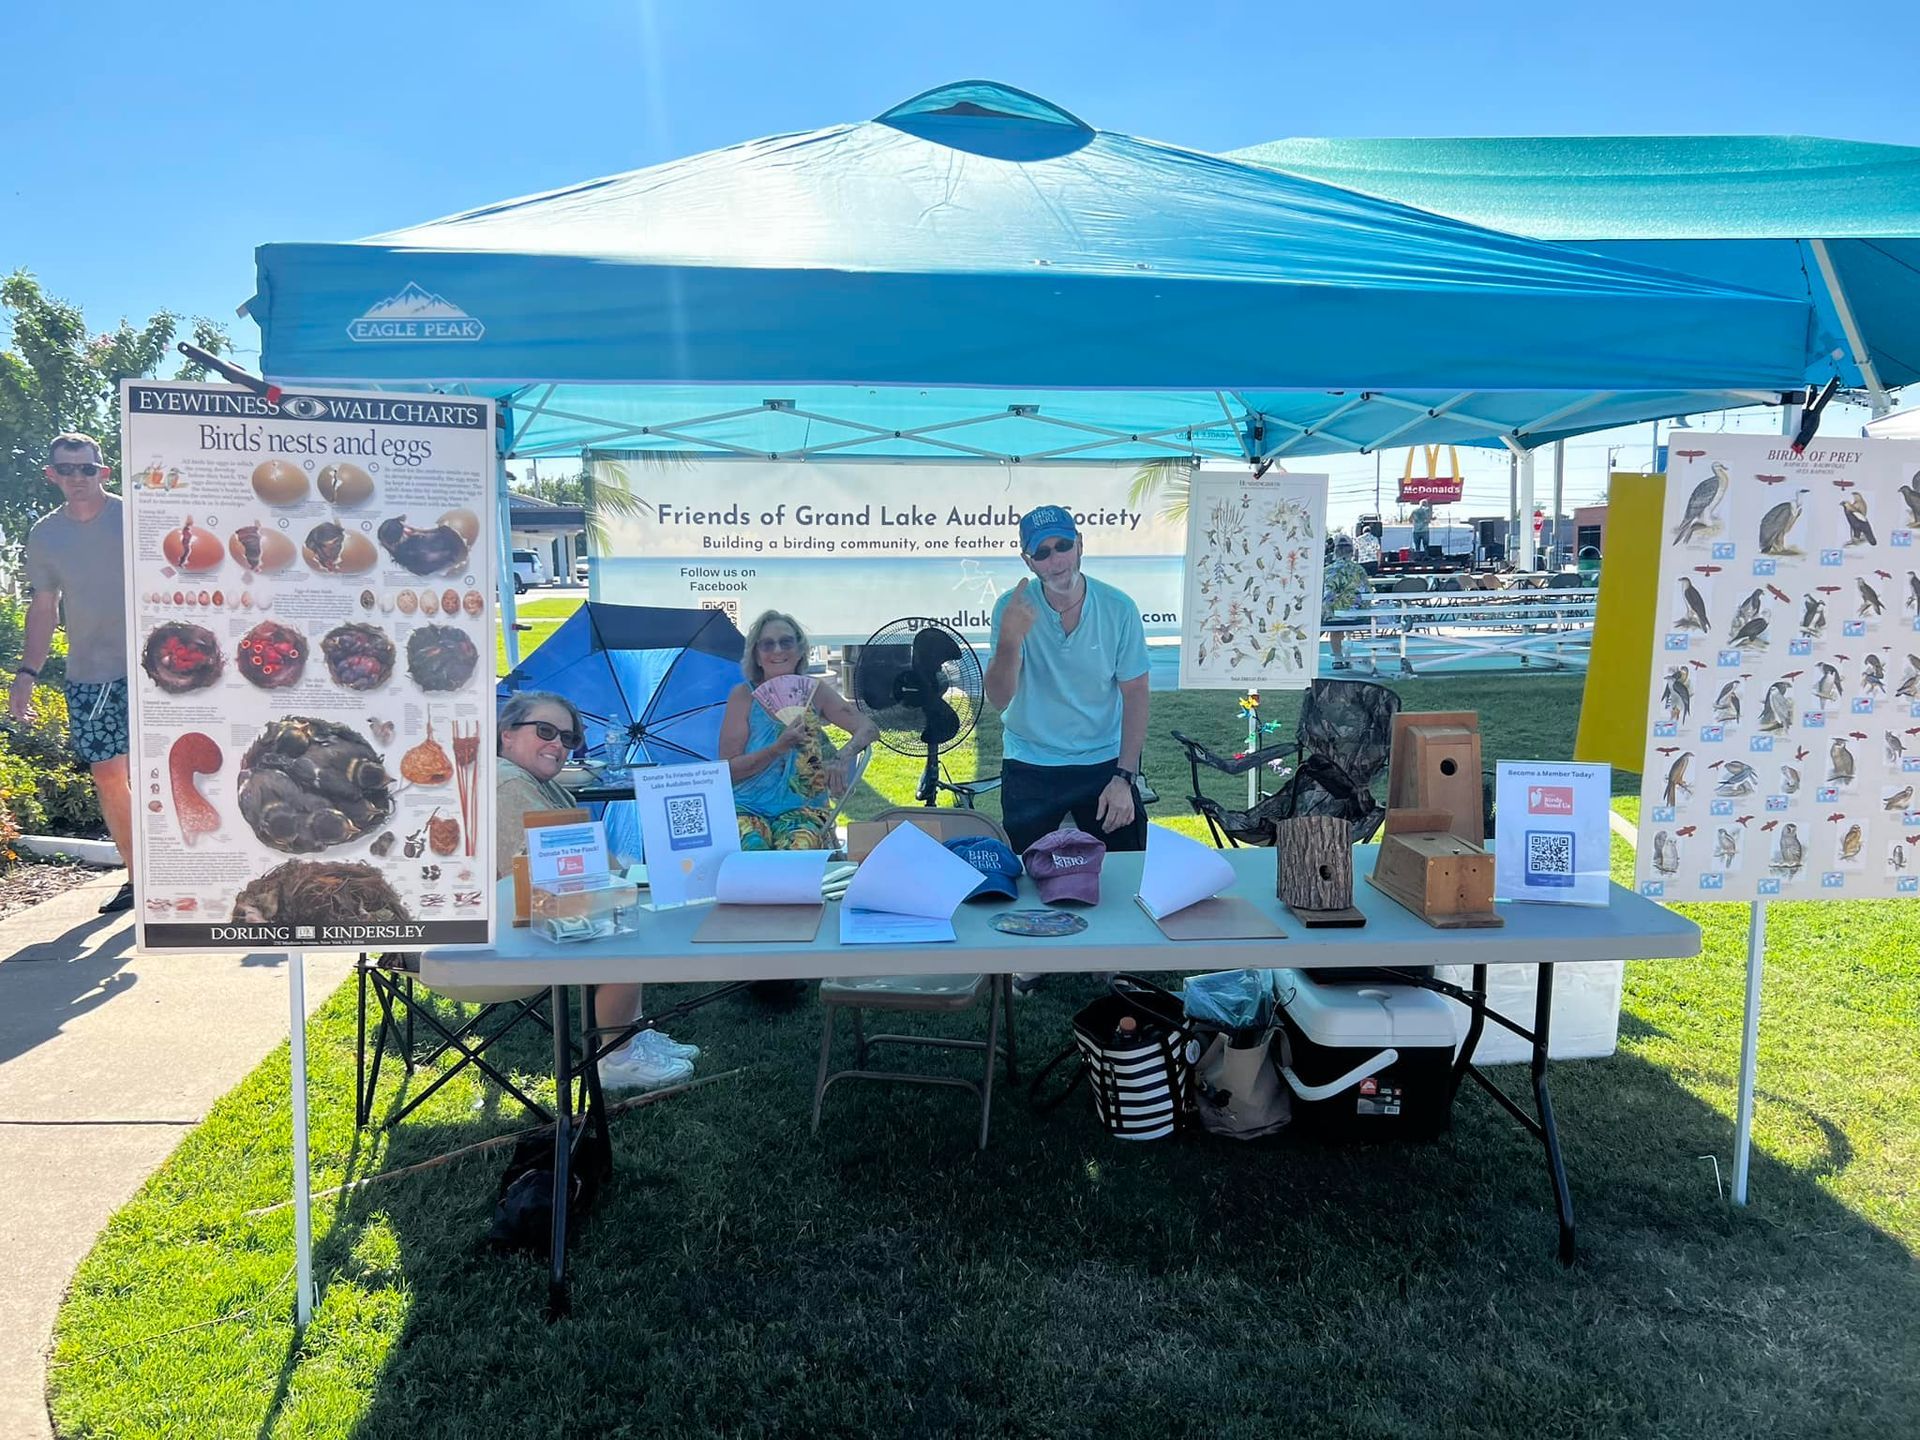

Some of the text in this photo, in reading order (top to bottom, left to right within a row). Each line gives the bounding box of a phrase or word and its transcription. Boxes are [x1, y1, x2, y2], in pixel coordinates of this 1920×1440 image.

[357, 322, 476, 336] EAGLE PEAK
[138, 391, 479, 426] EYEWITNESS WALLCHARTS
[269, 430, 328, 454] nests
[334, 428, 378, 457] and
[382, 437, 433, 466] eggs
[1767, 449, 1863, 464] BIRDS OF PREY
[1403, 486, 1460, 494] McDonald's
[658, 503, 750, 526] Friends
[760, 504, 786, 526] of
[795, 504, 871, 526] Grand
[881, 505, 937, 527] Lake
[946, 504, 1022, 527] Audub
[702, 535, 764, 552] Building
[769, 540, 778, 549] a
[783, 536, 836, 552] birding
[840, 537, 920, 553] community,
[925, 540, 950, 550] one
[955, 536, 1004, 549] feather
[680, 567, 757, 578] Follow us on
[690, 582, 748, 592] Facebook
[1508, 769, 1535, 777] Become
[968, 850, 999, 862] BIRD
[211, 926, 290, 941] DORLING
[322, 924, 426, 939] KINDERSLEY
